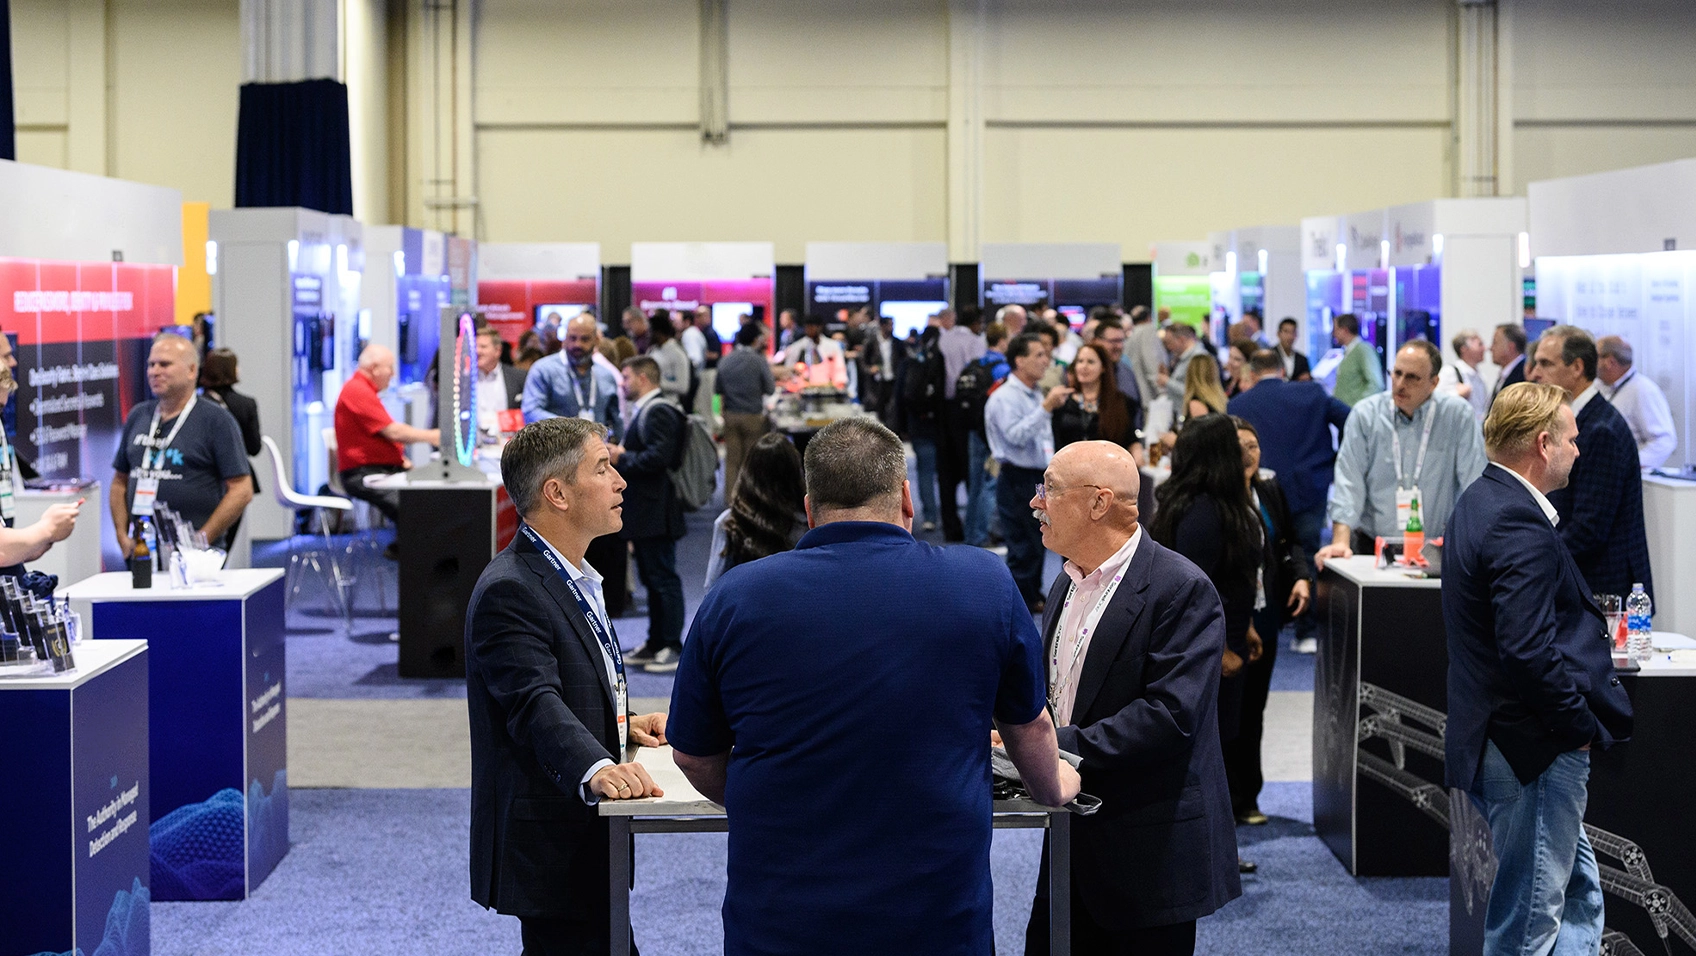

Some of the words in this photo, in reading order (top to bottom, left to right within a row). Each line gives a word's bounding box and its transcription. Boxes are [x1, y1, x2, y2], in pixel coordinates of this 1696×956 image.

[543, 549, 562, 571] Gartner
[566, 579, 583, 602] Gartner
[586, 611, 602, 634] Gartner
[87, 814, 97, 833] The
[97, 799, 117, 825] Authority
[89, 830, 111, 858] Detection
